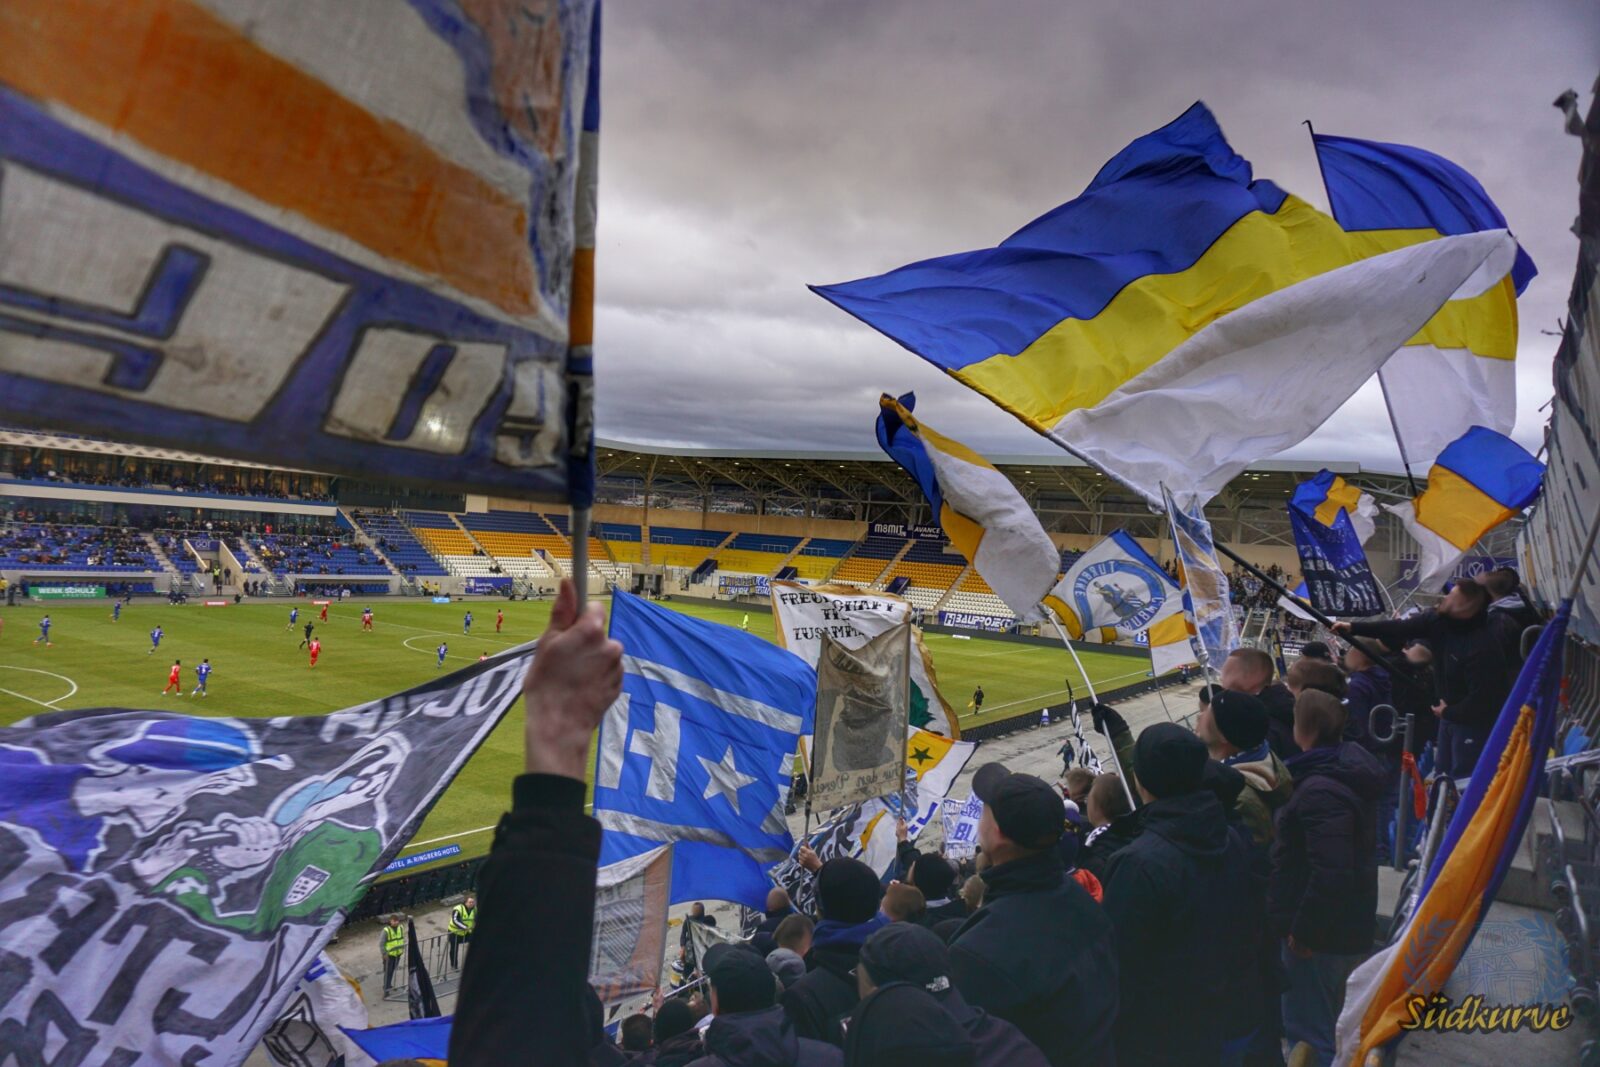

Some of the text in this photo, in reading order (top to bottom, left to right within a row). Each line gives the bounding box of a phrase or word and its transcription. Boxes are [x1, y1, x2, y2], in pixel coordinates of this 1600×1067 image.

[914, 526, 941, 534] AVANCE
[413, 849, 442, 864] RINGBERG
[442, 845, 461, 857] HOTEL
